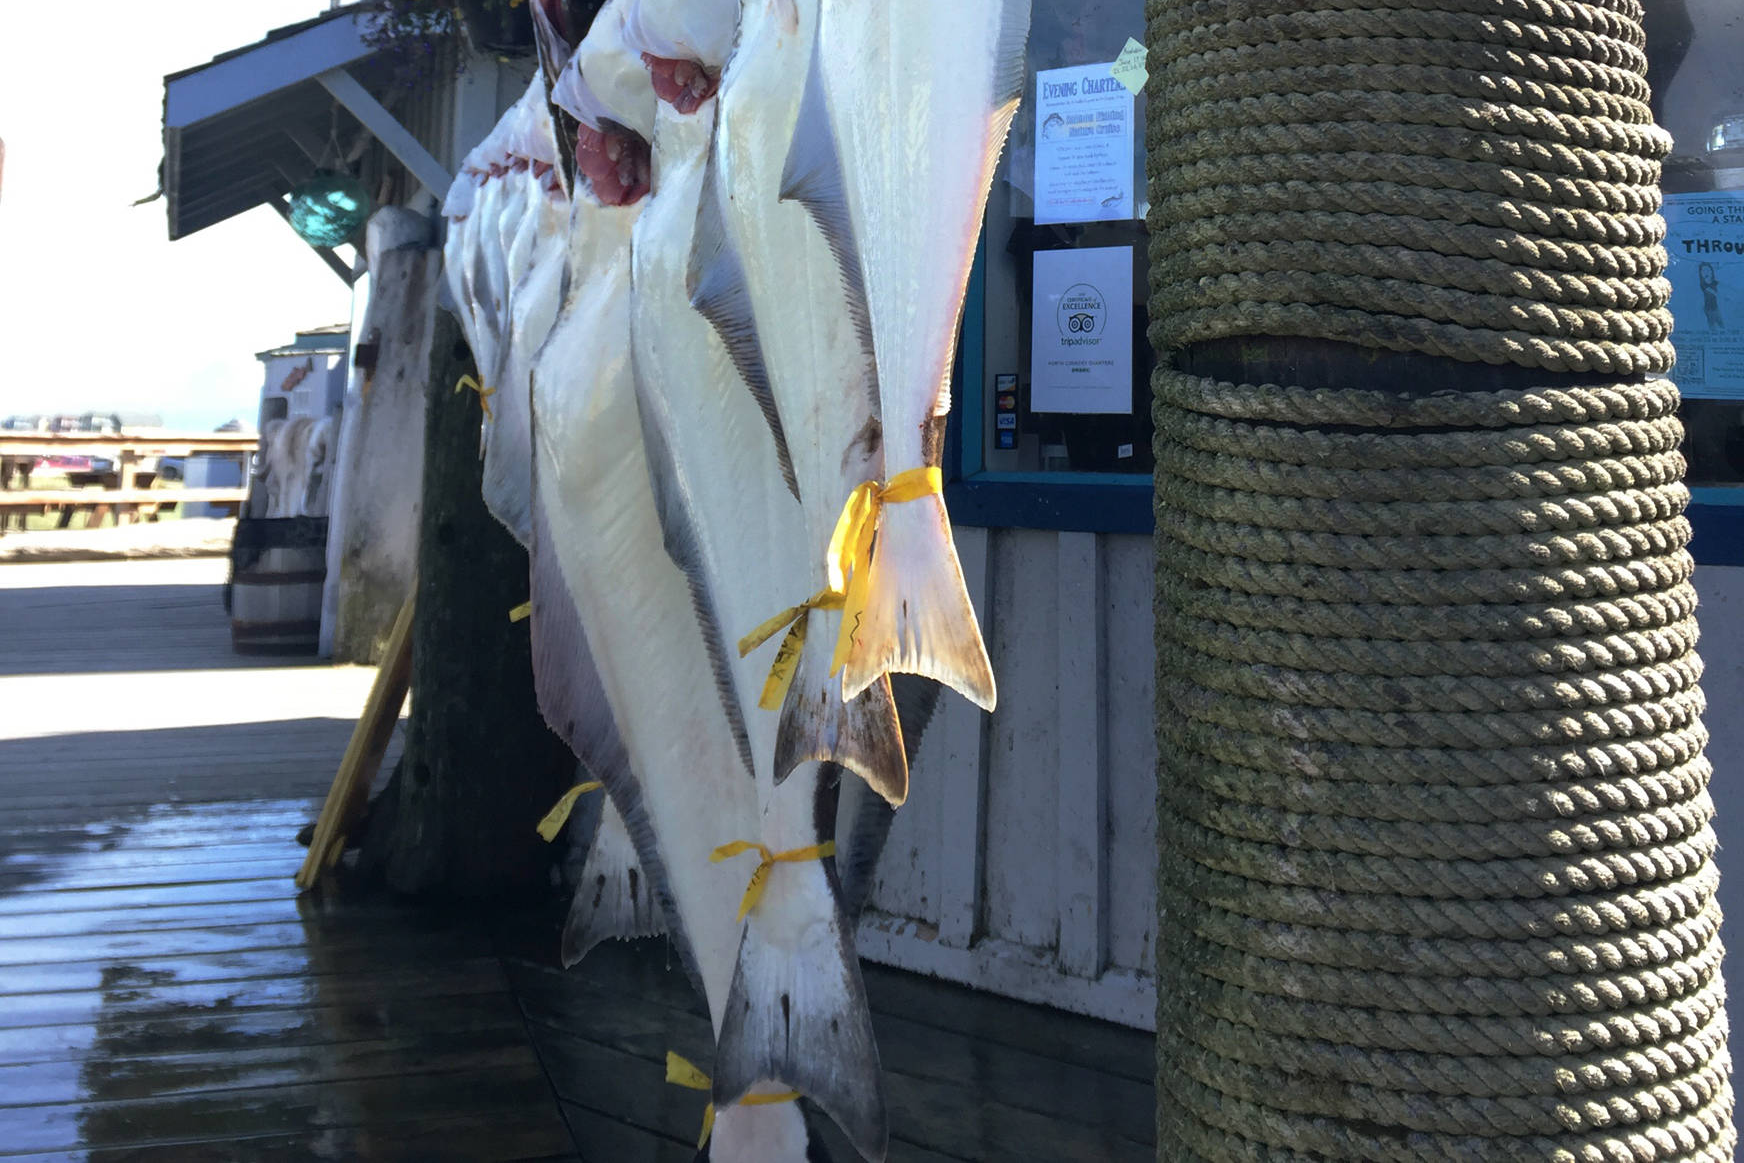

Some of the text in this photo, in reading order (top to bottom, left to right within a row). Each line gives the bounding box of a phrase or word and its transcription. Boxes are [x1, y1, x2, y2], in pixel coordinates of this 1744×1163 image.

[1043, 77, 1126, 99] EVENING CHARTER
[1688, 205, 1744, 215] GOING TH
[1712, 214, 1744, 223] A STA
[1062, 302, 1101, 310] EXCELLENCE
[1061, 337, 1099, 346] tripadvisor
